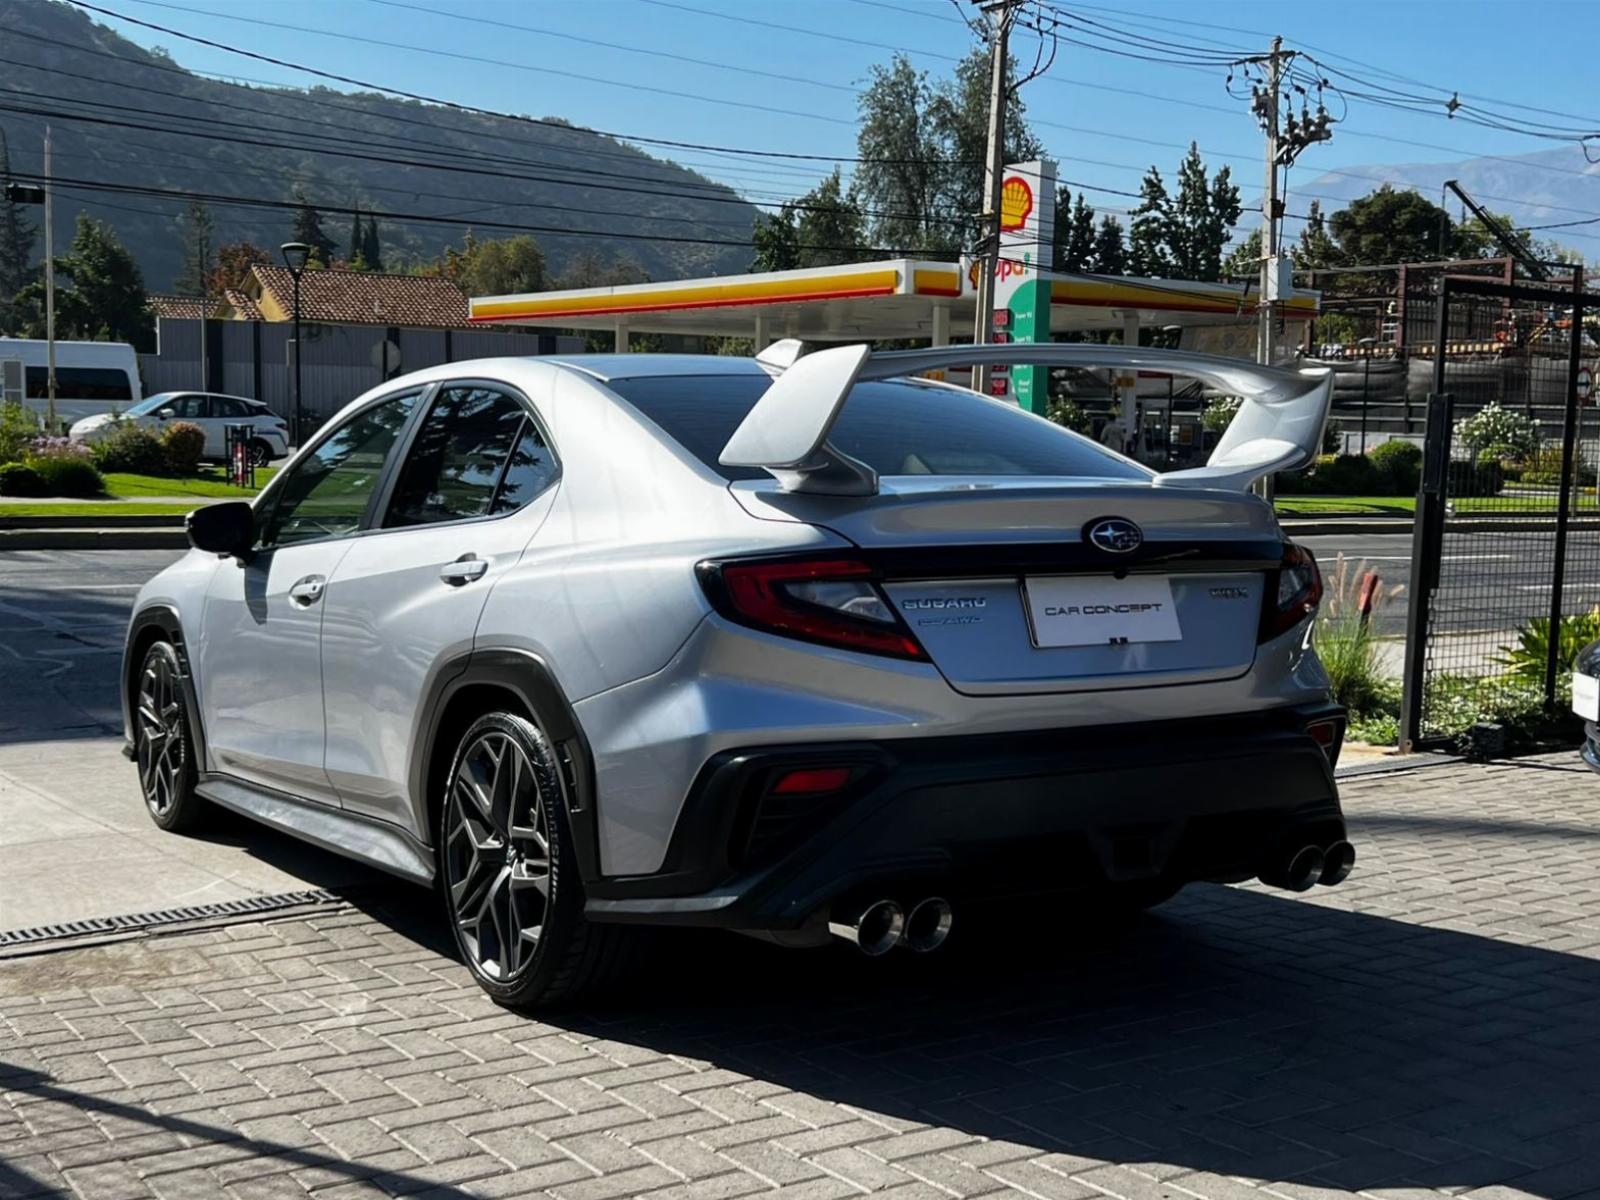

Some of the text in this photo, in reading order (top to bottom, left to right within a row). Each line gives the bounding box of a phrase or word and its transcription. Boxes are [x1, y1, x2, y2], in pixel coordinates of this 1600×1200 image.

[902, 597, 986, 610] SUBARU
[1044, 603, 1163, 617] CAR CONCEPT
